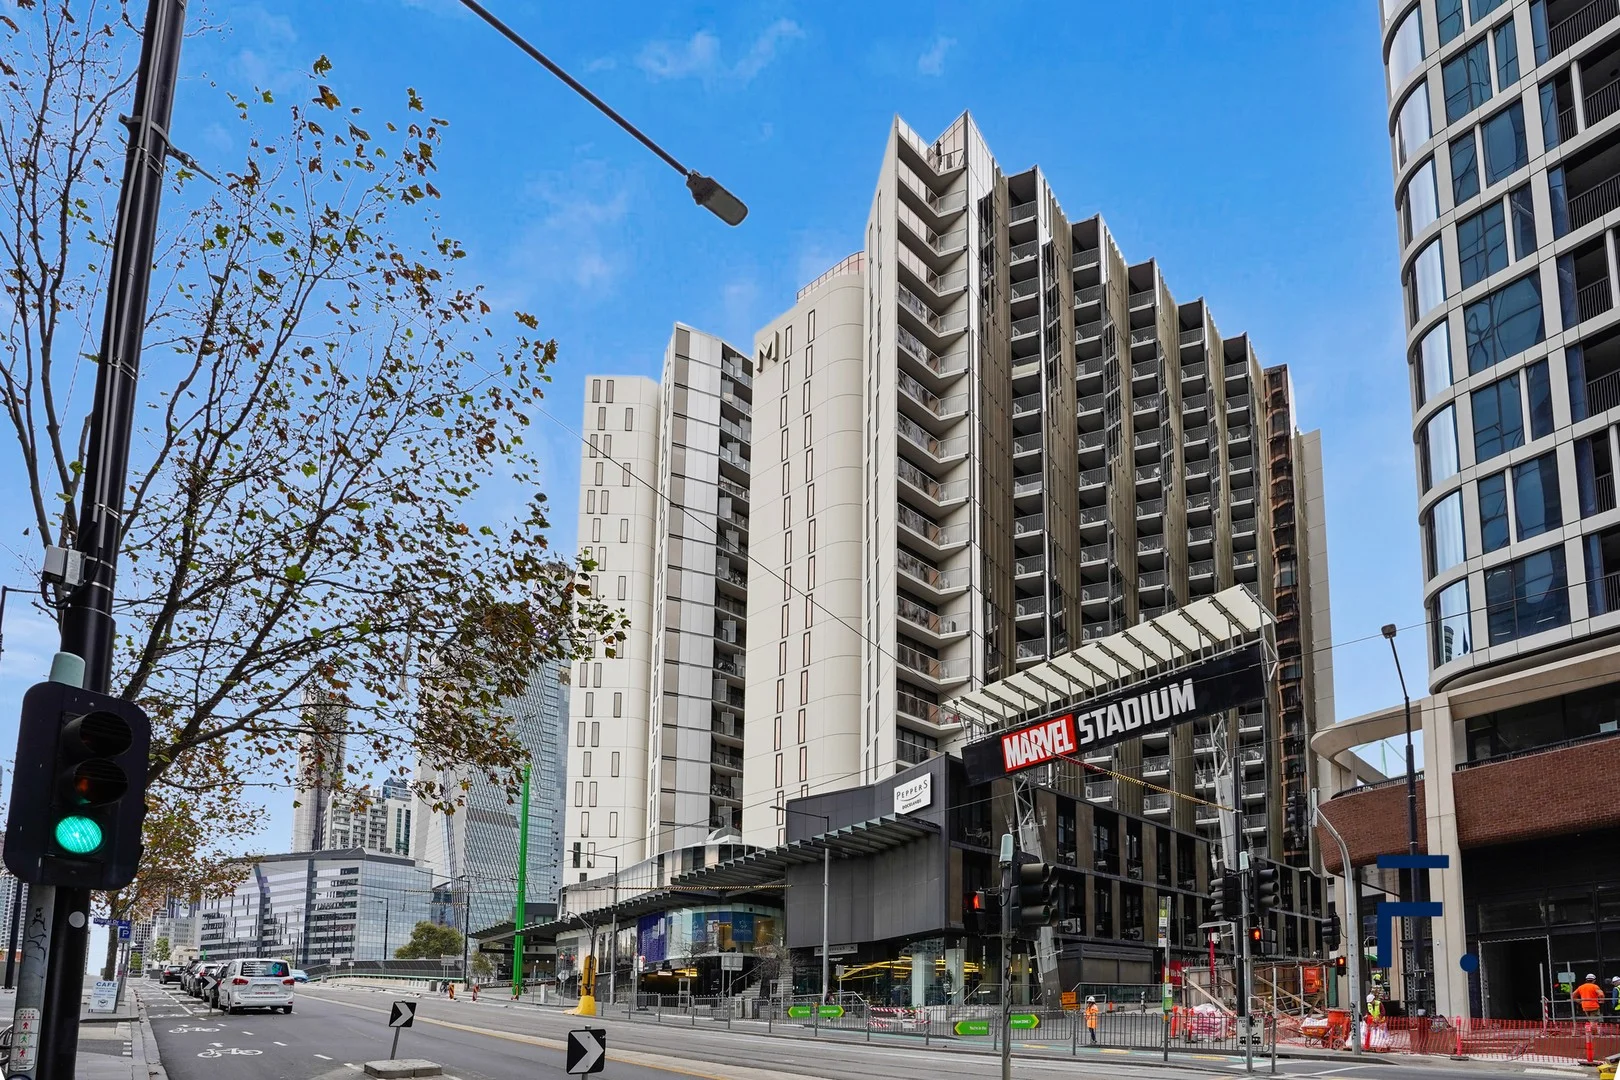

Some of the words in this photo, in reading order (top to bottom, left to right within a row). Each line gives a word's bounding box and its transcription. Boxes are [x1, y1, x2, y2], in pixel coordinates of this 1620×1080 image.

[1003, 719, 1074, 769] MARVEL
[1078, 678, 1196, 745] STADIUM
[896, 779, 928, 801] PEPPERS
